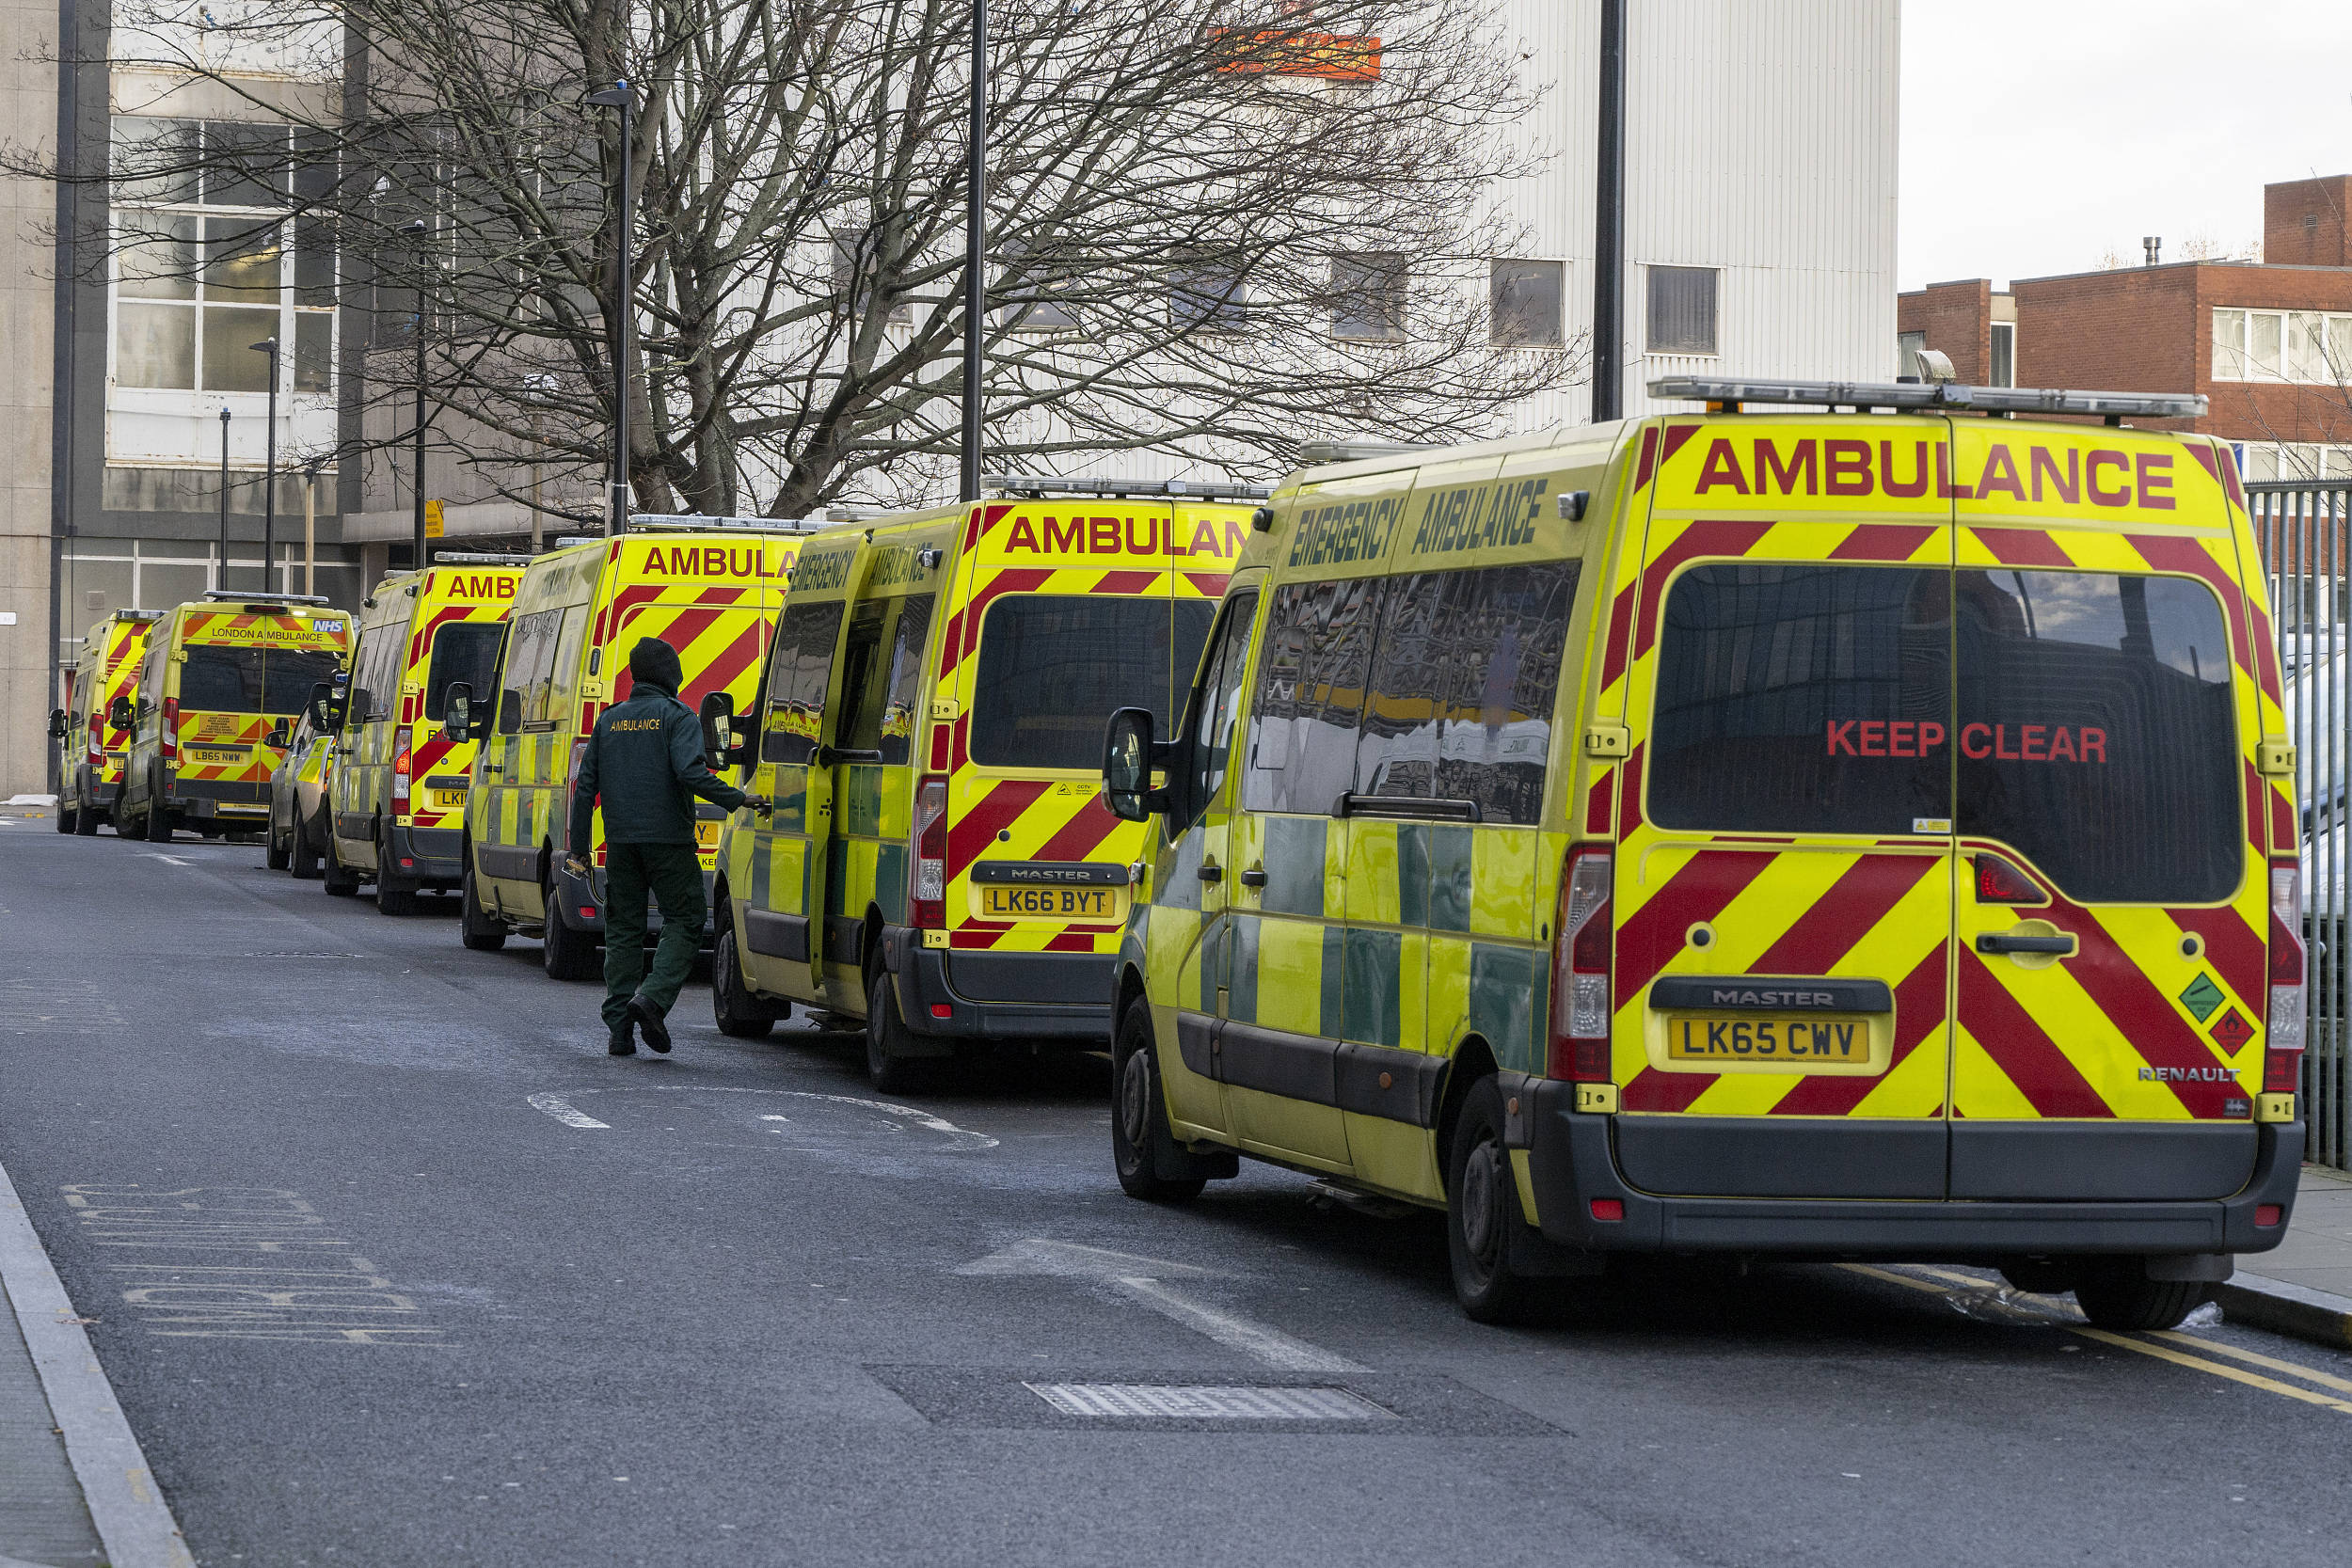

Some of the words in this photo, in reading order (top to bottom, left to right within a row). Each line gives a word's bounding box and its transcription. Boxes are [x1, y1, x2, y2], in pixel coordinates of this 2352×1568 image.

[1694, 438, 2176, 510] AMBULANCE
[1288, 497, 1405, 567] EMERGENCY
[1412, 479, 1549, 555] AMBULANCE
[790, 549, 856, 593] EMERGENCY
[868, 542, 932, 587] AMBULANCE
[448, 576, 522, 598] AMB
[212, 628, 255, 639] LONDON
[257, 631, 323, 641] AMBULANCE
[313, 620, 342, 632] NHS
[610, 718, 660, 732] AMBULANCE
[1827, 720, 1945, 757] KEEP
[1961, 722, 2106, 763] CLEAR
[196, 752, 219, 761] LB65
[1011, 870, 1090, 880] MASTER
[993, 891, 1054, 911] LK66
[1061, 892, 1105, 912] BYT
[1712, 990, 1834, 1006] MASTER
[1684, 1022, 1776, 1054] LK65
[1788, 1023, 1854, 1055] CWV
[2138, 1068, 2241, 1082] RENAULT
